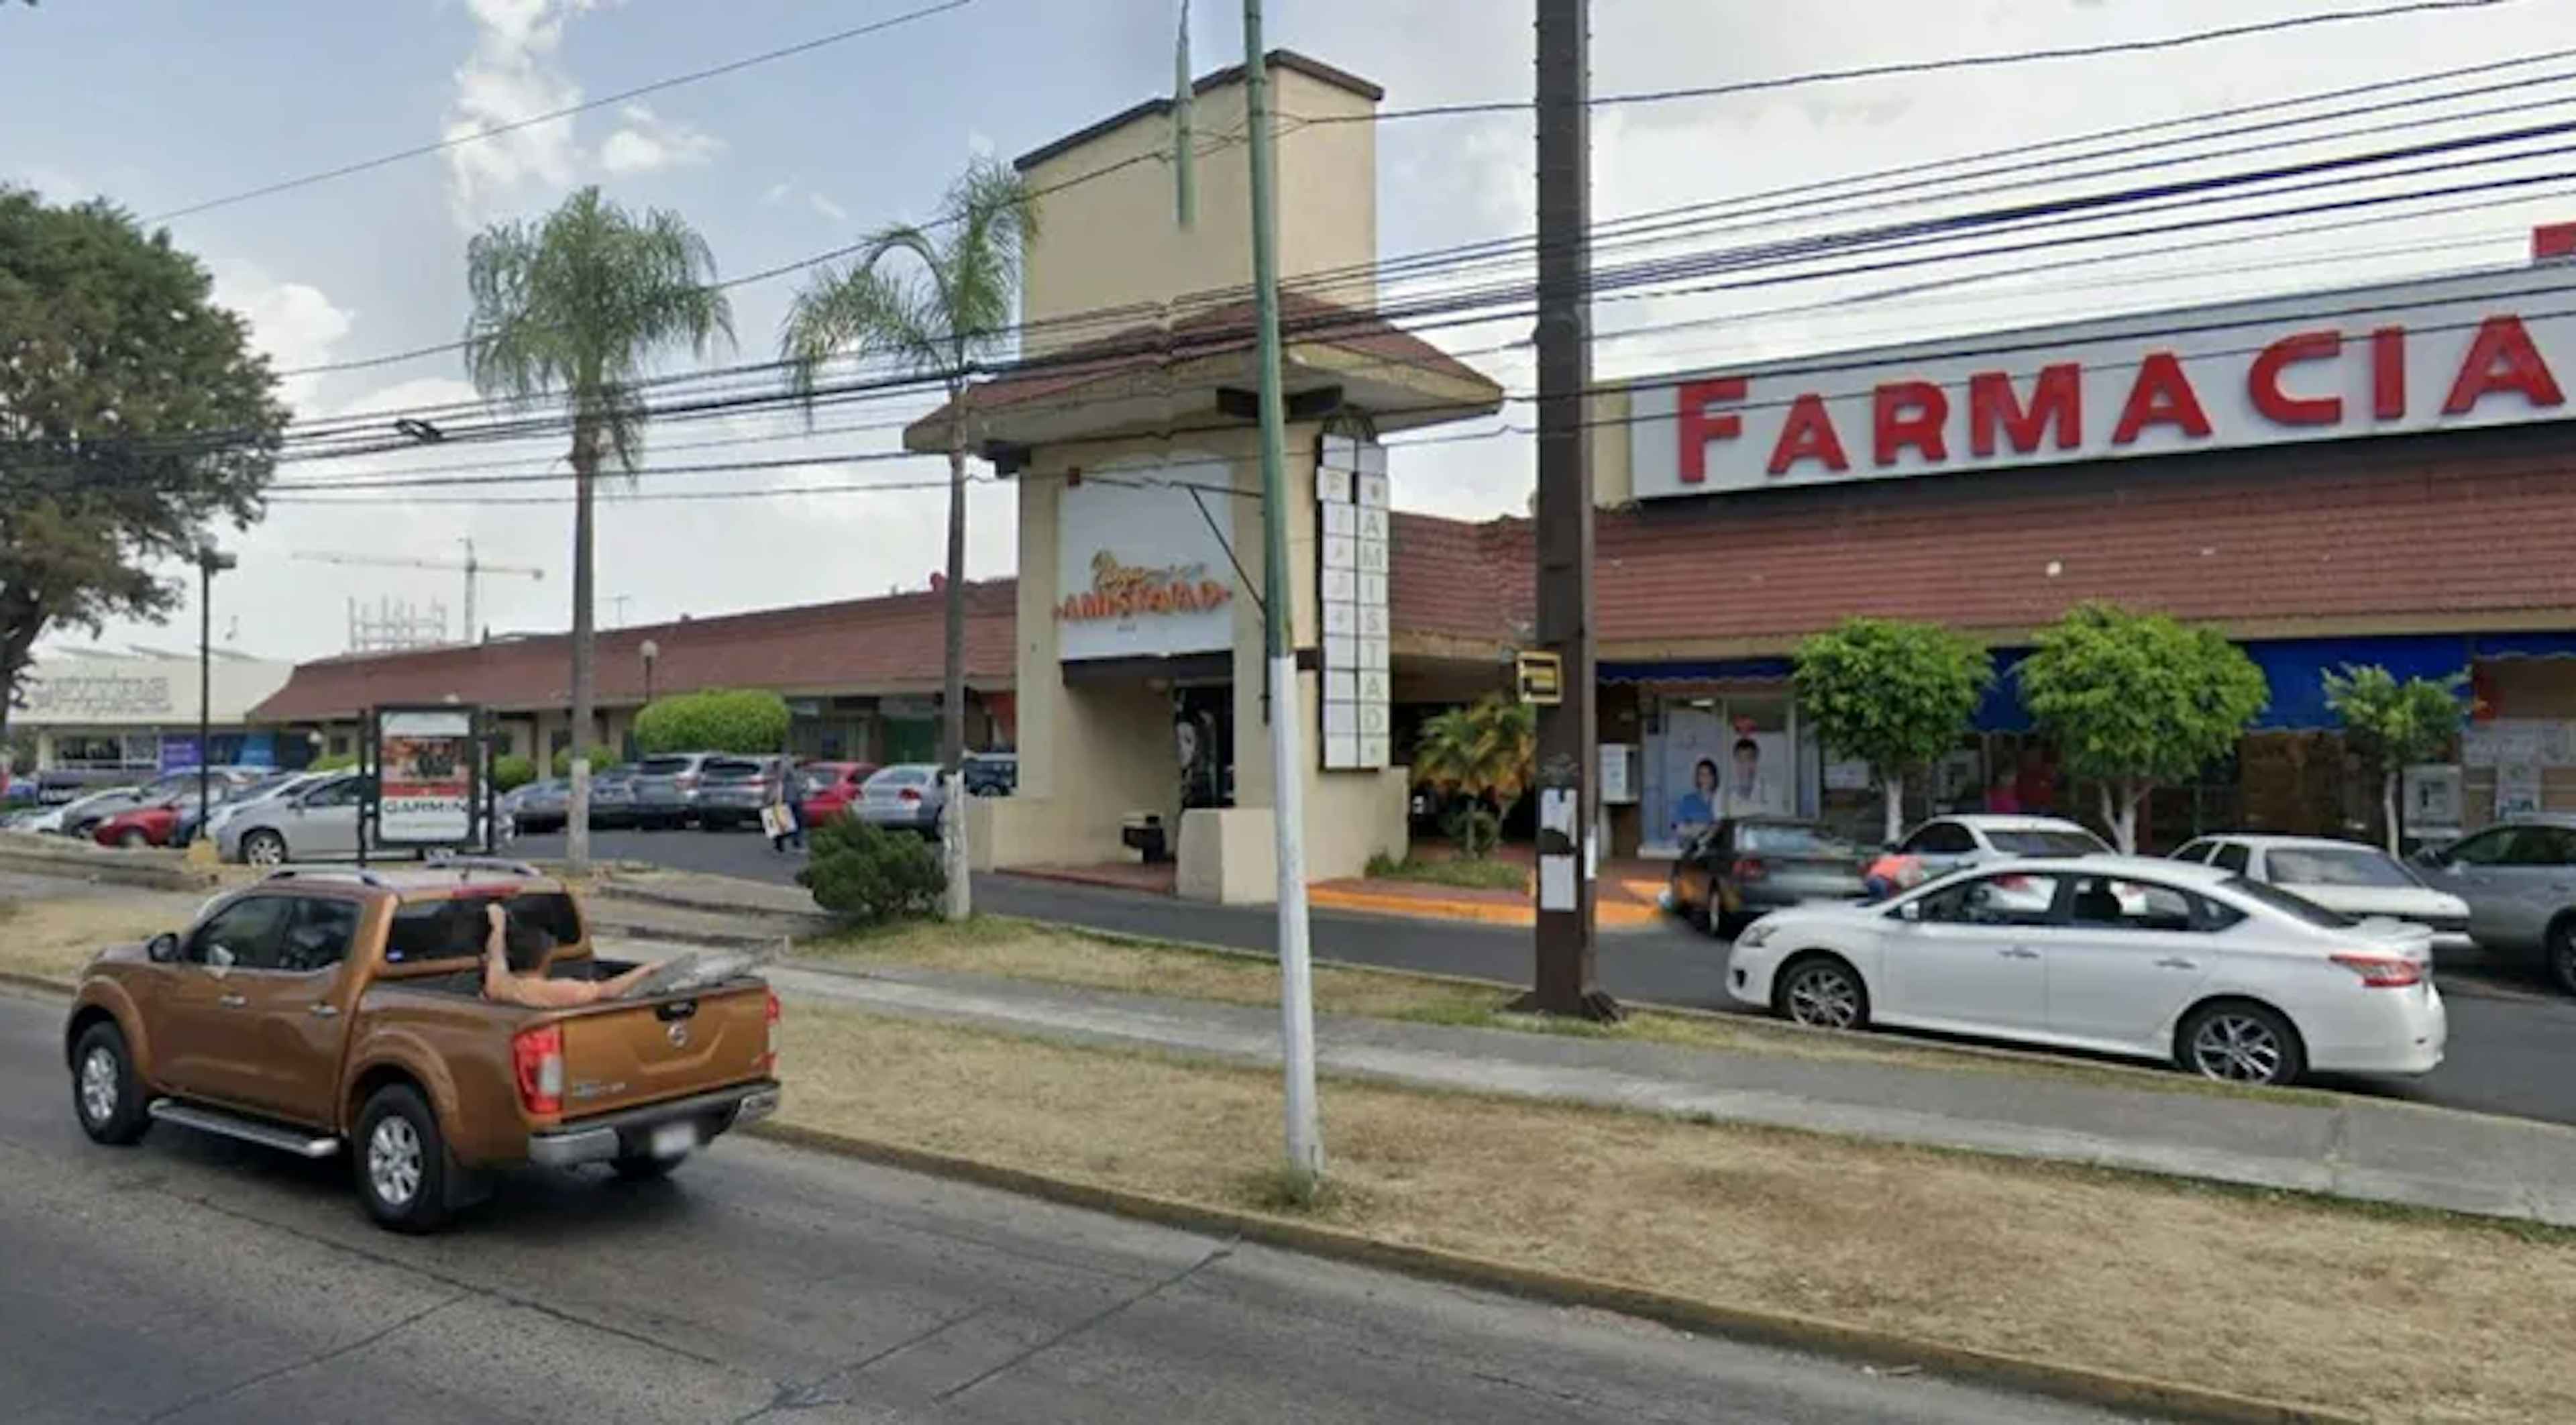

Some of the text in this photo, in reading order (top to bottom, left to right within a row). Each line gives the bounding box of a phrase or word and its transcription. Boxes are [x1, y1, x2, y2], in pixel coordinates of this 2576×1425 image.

[1676, 314, 2568, 484] FARMACIA
[1362, 513, 1382, 730] AMISTAD
[384, 801, 469, 814] GARMIN
